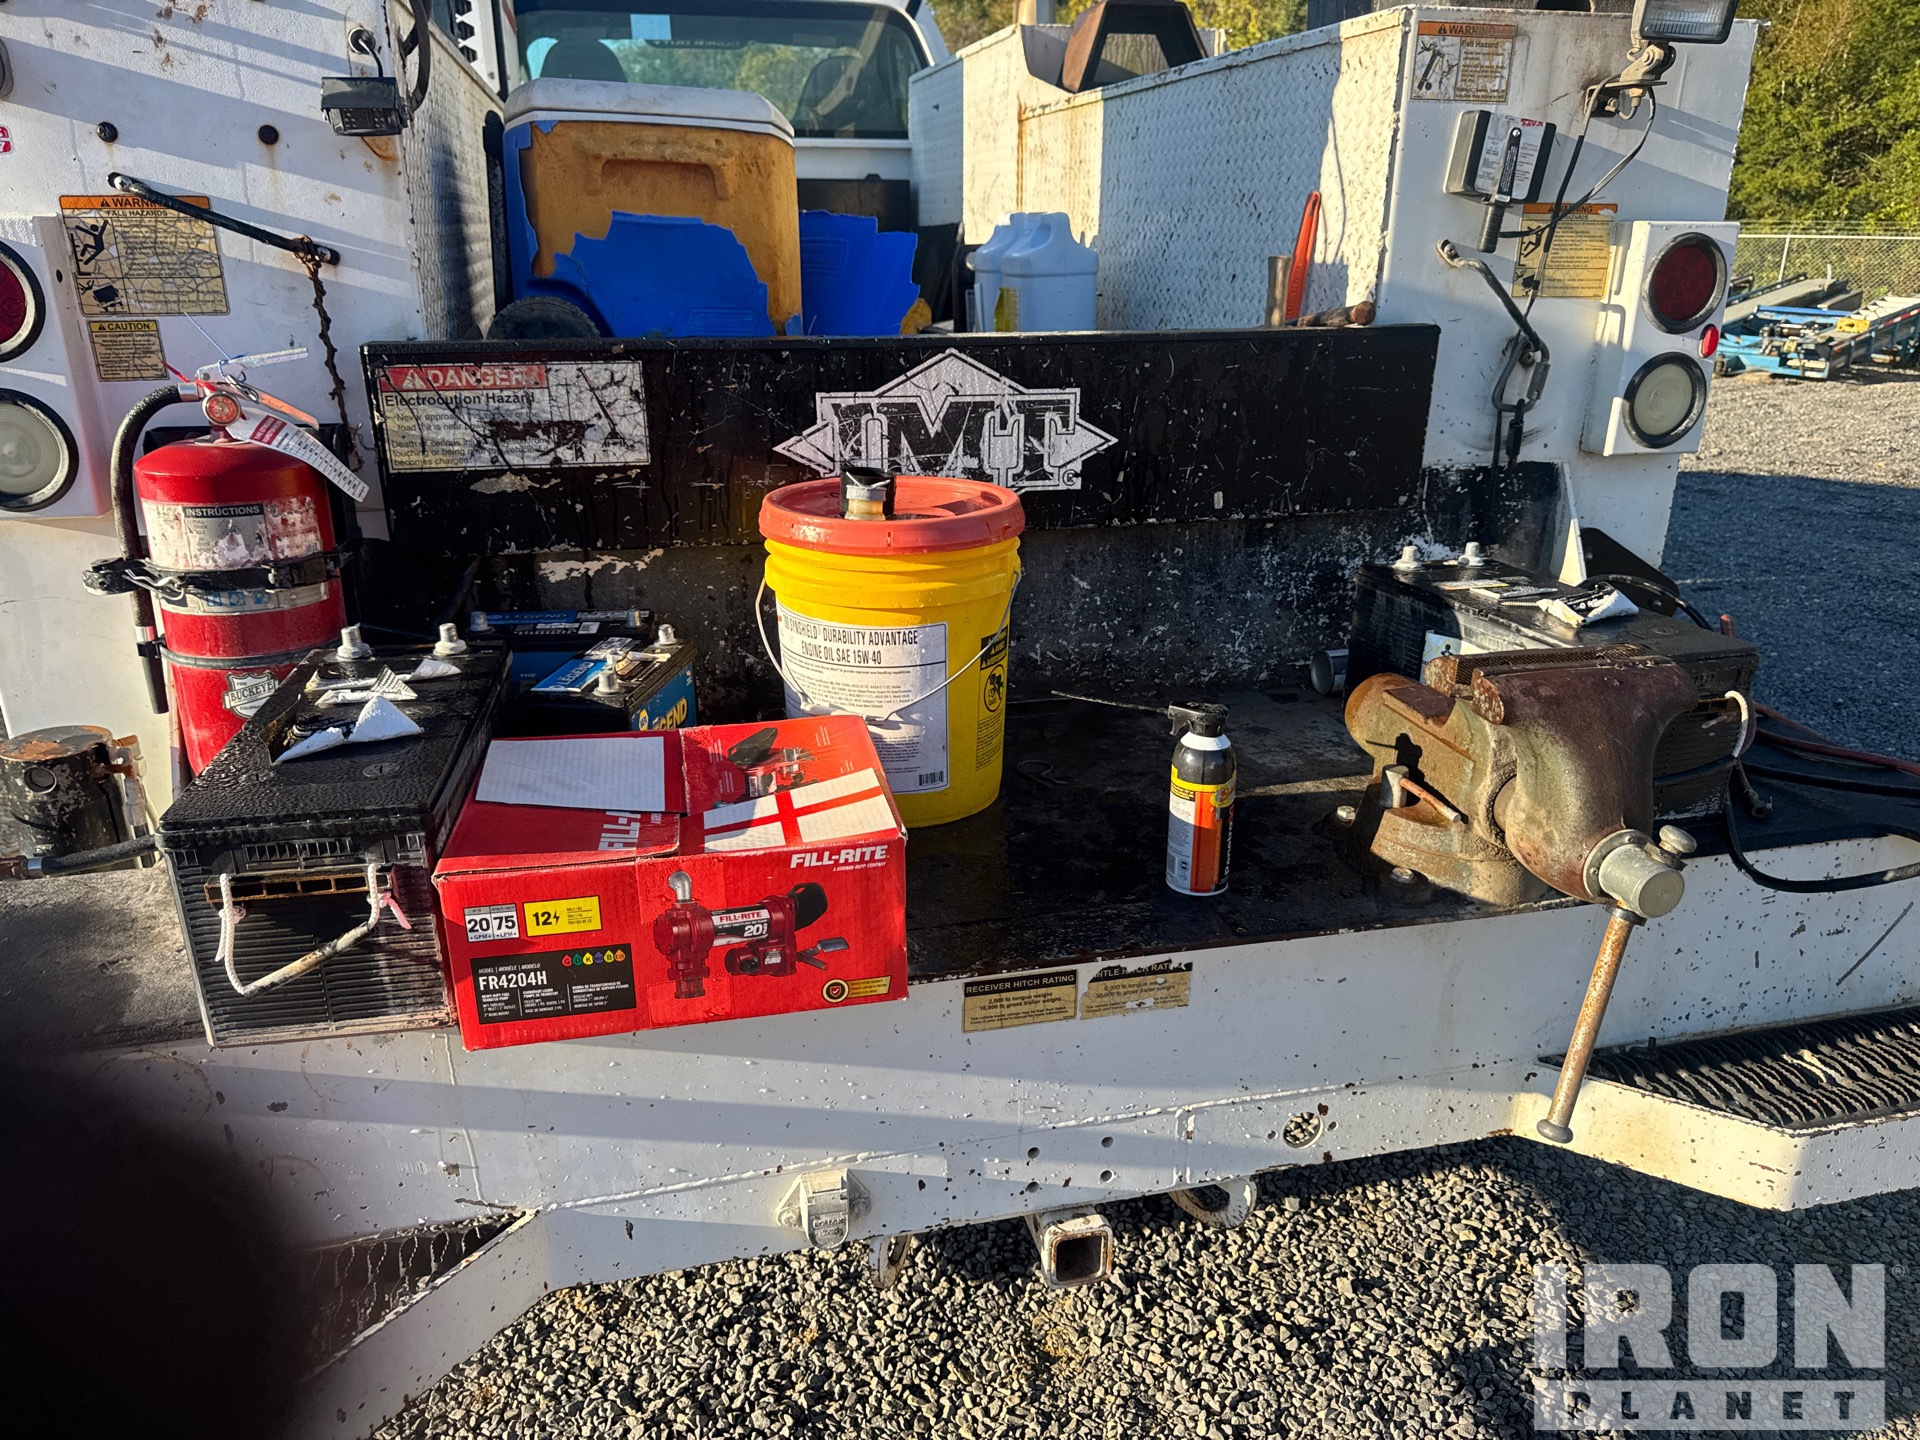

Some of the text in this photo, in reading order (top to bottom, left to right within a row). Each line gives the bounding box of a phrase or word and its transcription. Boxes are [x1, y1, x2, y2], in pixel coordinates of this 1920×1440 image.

[108, 322, 151, 330] CAUTION
[428, 368, 525, 387] DANGER
[186, 505, 260, 517] INSTRUCTIONS
[822, 627, 866, 646] DURABILITY
[868, 630, 918, 646] ADVANTAGE
[802, 641, 882, 665] ENGINE OIL SAE 15W-40
[230, 680, 274, 702] BUCKEYE
[790, 844, 888, 869] FILL-RITE
[467, 915, 516, 932] 20 75
[533, 911, 552, 926] 12
[719, 911, 762, 922] FILL-RITE
[744, 924, 762, 937] 20
[522, 962, 541, 970] MODELO
[479, 970, 547, 990] FR4204H
[966, 974, 1074, 994] RECEIVER HITCH RATING
[1012, 994, 1032, 1002] tongue
